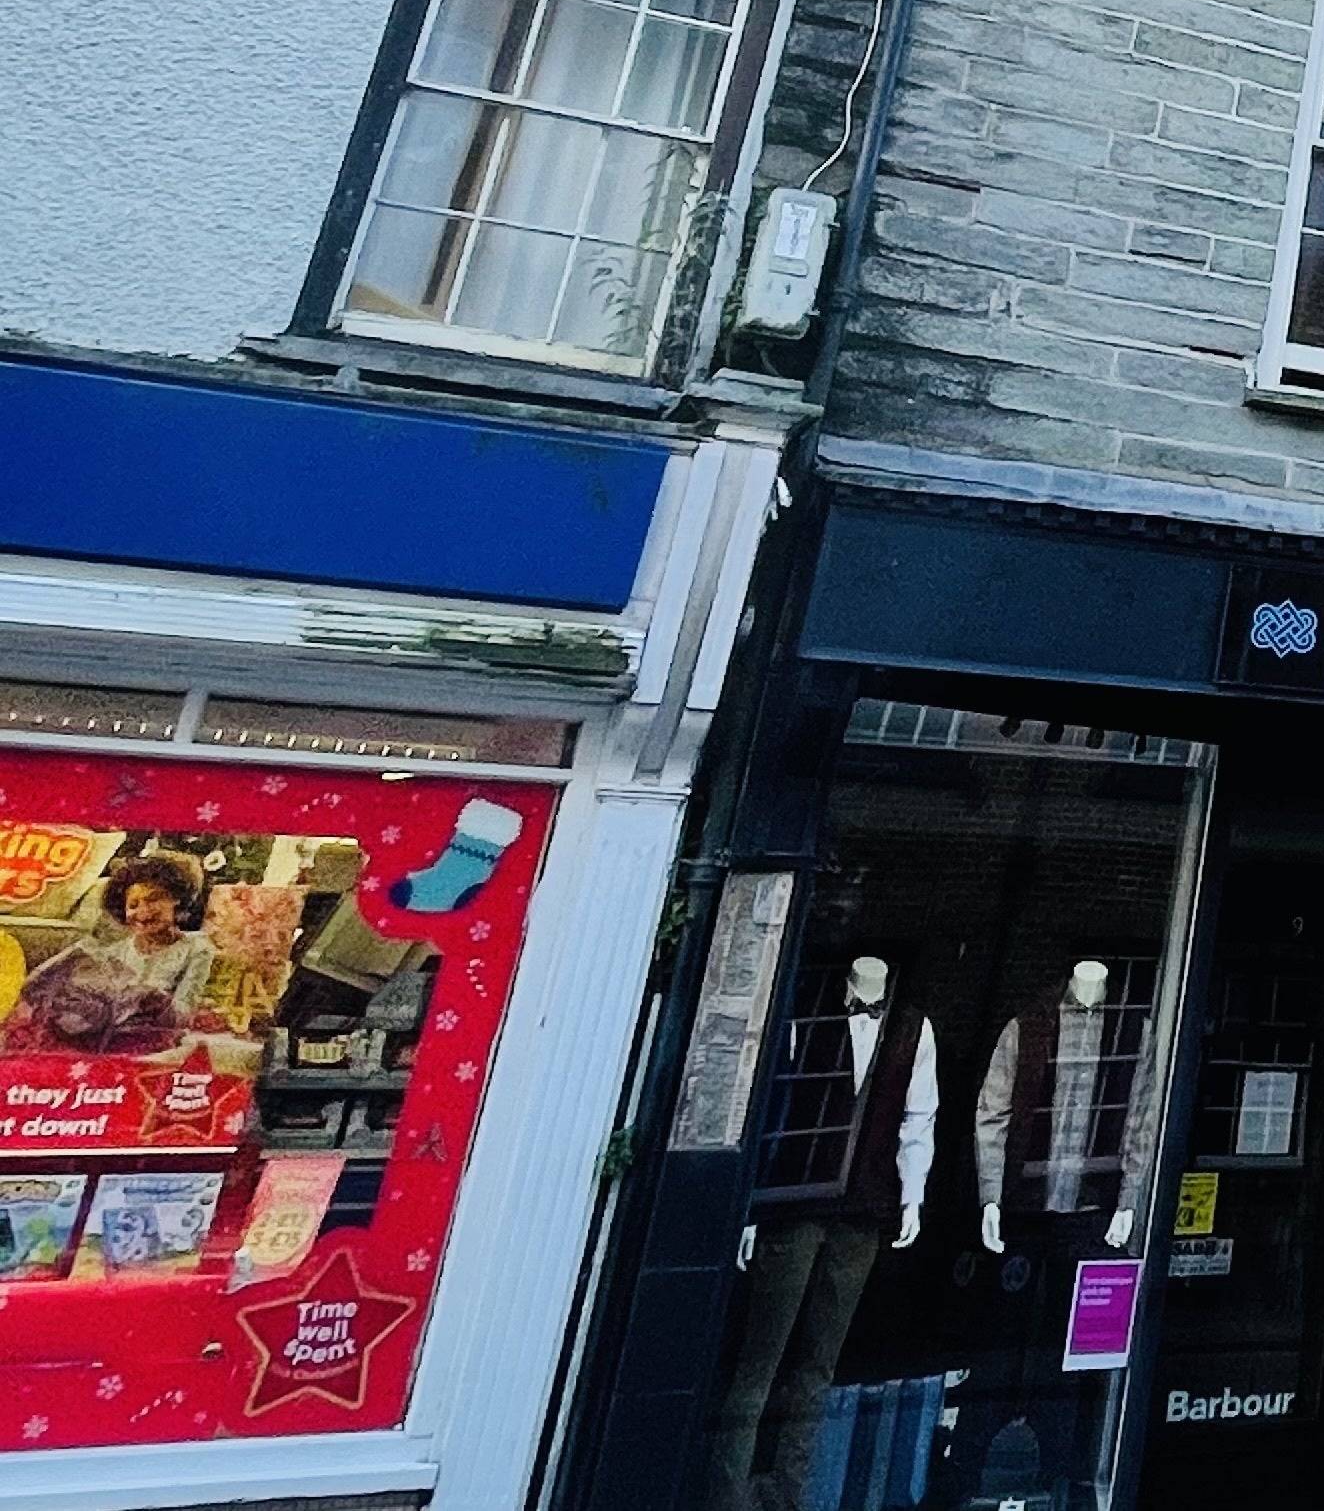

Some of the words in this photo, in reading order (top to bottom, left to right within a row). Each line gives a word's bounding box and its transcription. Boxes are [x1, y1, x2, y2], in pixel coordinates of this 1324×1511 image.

[7, 1084, 71, 1109] they
[70, 1083, 126, 1110] just
[21, 1113, 109, 1137] down!
[297, 1299, 358, 1324] Time
[298, 1319, 349, 1342] well
[284, 1338, 356, 1366] spent
[1166, 1387, 1296, 1423] Barbour
